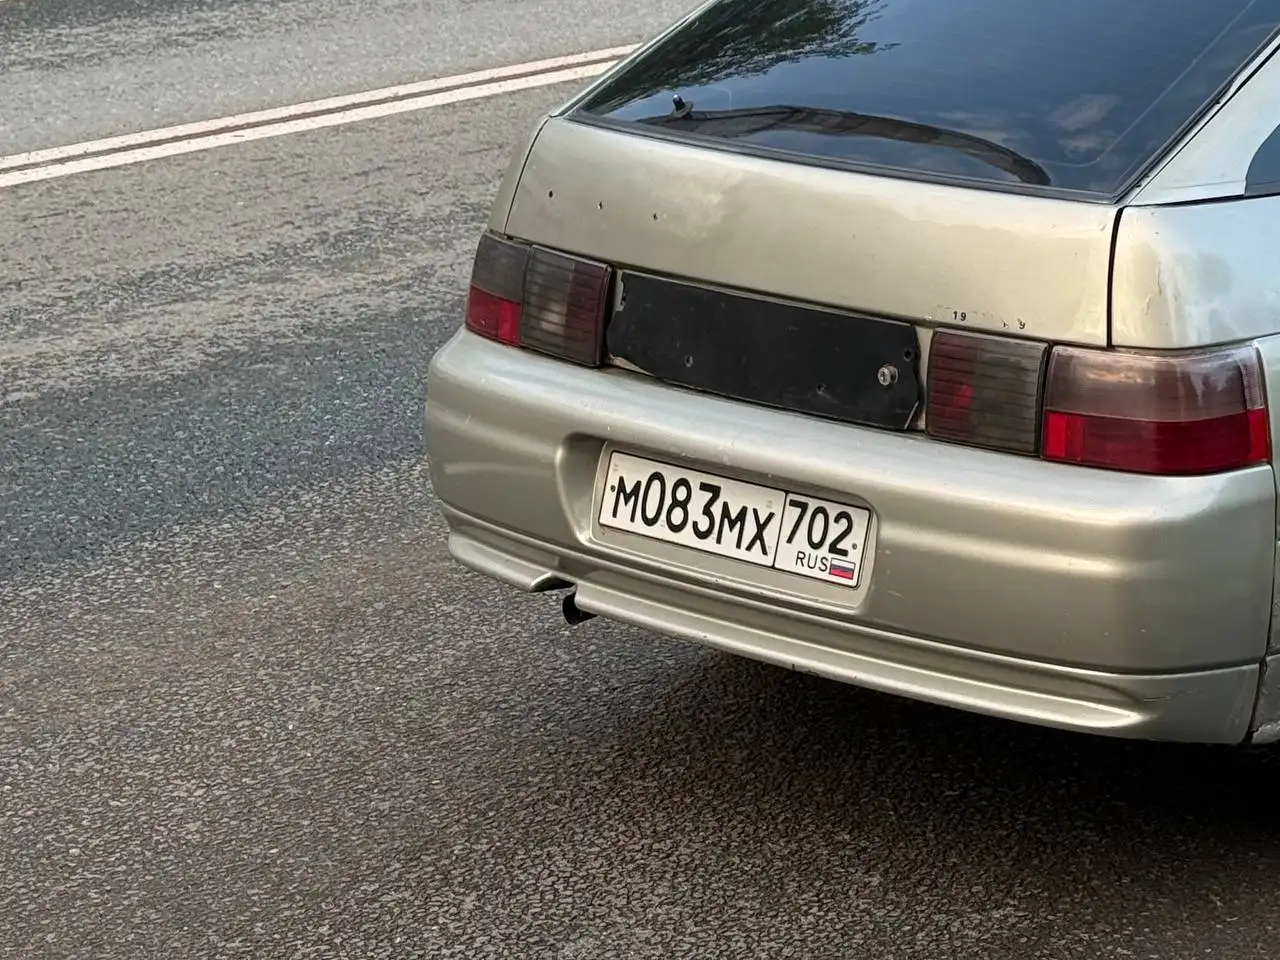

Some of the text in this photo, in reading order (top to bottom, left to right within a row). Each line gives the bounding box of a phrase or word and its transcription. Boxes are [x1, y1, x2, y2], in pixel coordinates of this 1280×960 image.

[611, 471, 854, 557] М083МХ 702
[795, 550, 829, 573] RUS
